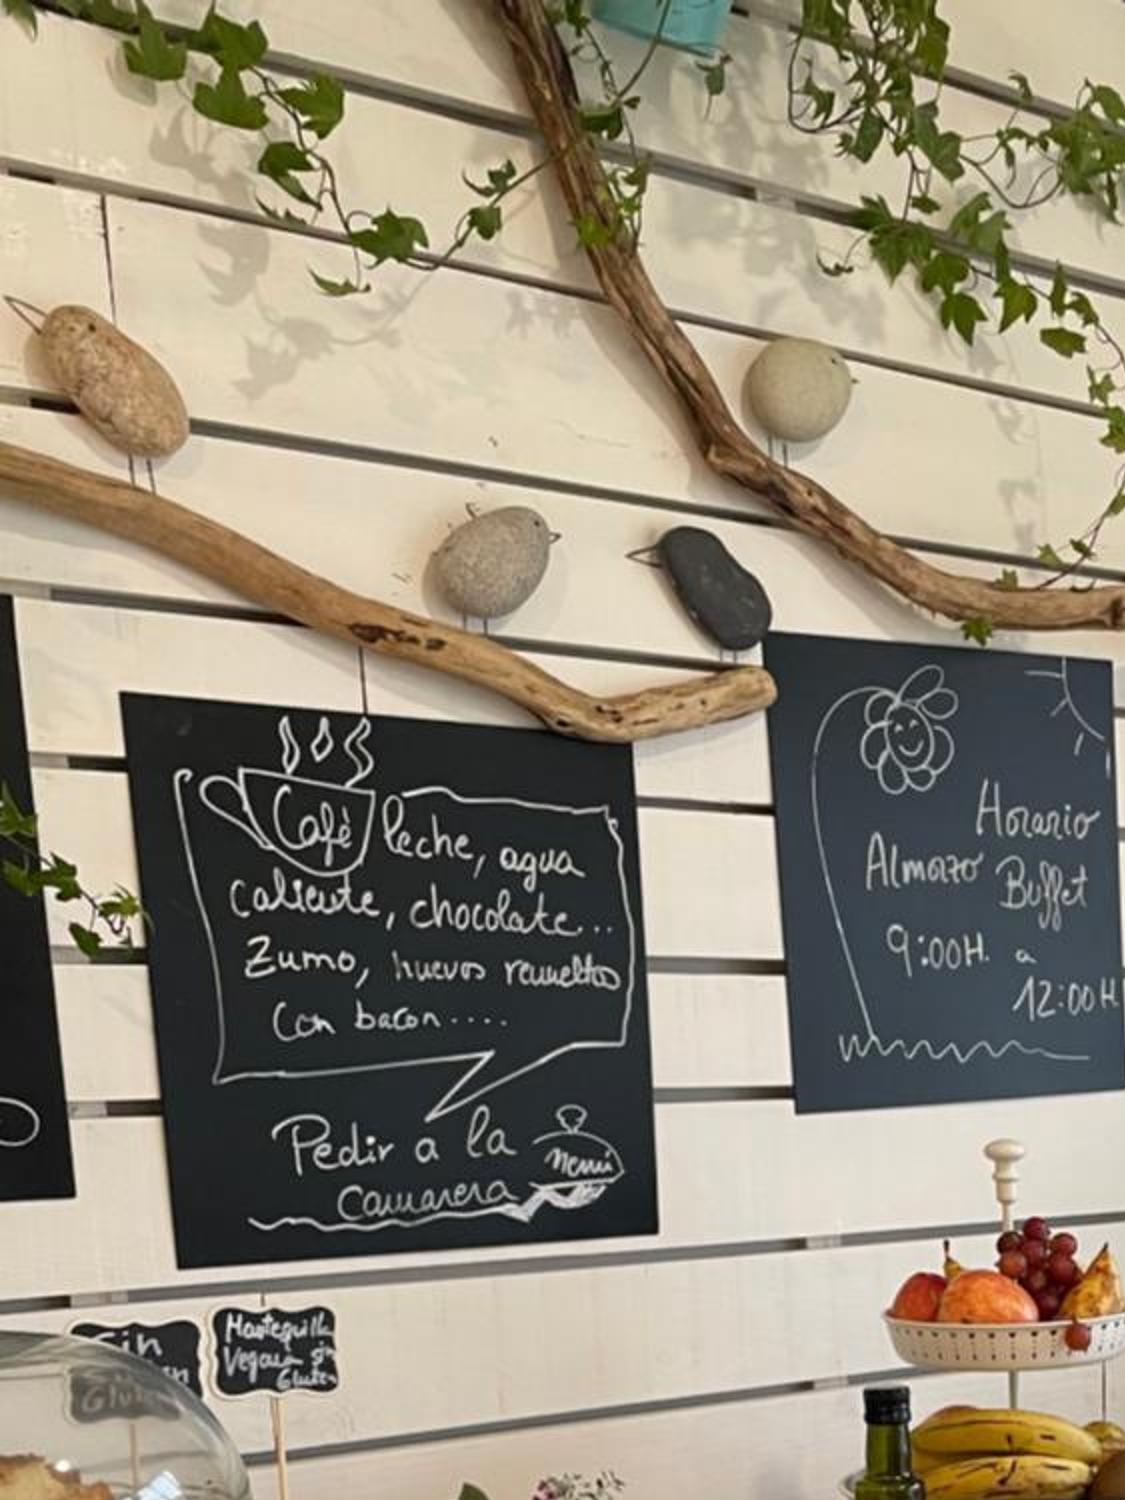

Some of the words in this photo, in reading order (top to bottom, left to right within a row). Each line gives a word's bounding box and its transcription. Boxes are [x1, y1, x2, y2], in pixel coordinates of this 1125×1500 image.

[975, 779, 1101, 840] Horario
[499, 848, 586, 892] agua
[995, 855, 1088, 930] Buffet
[392, 950, 485, 981] huevos
[1015, 949, 1038, 963] a
[272, 1114, 395, 1176] Pedir
[415, 1137, 440, 1163] a
[467, 1105, 517, 1158] la
